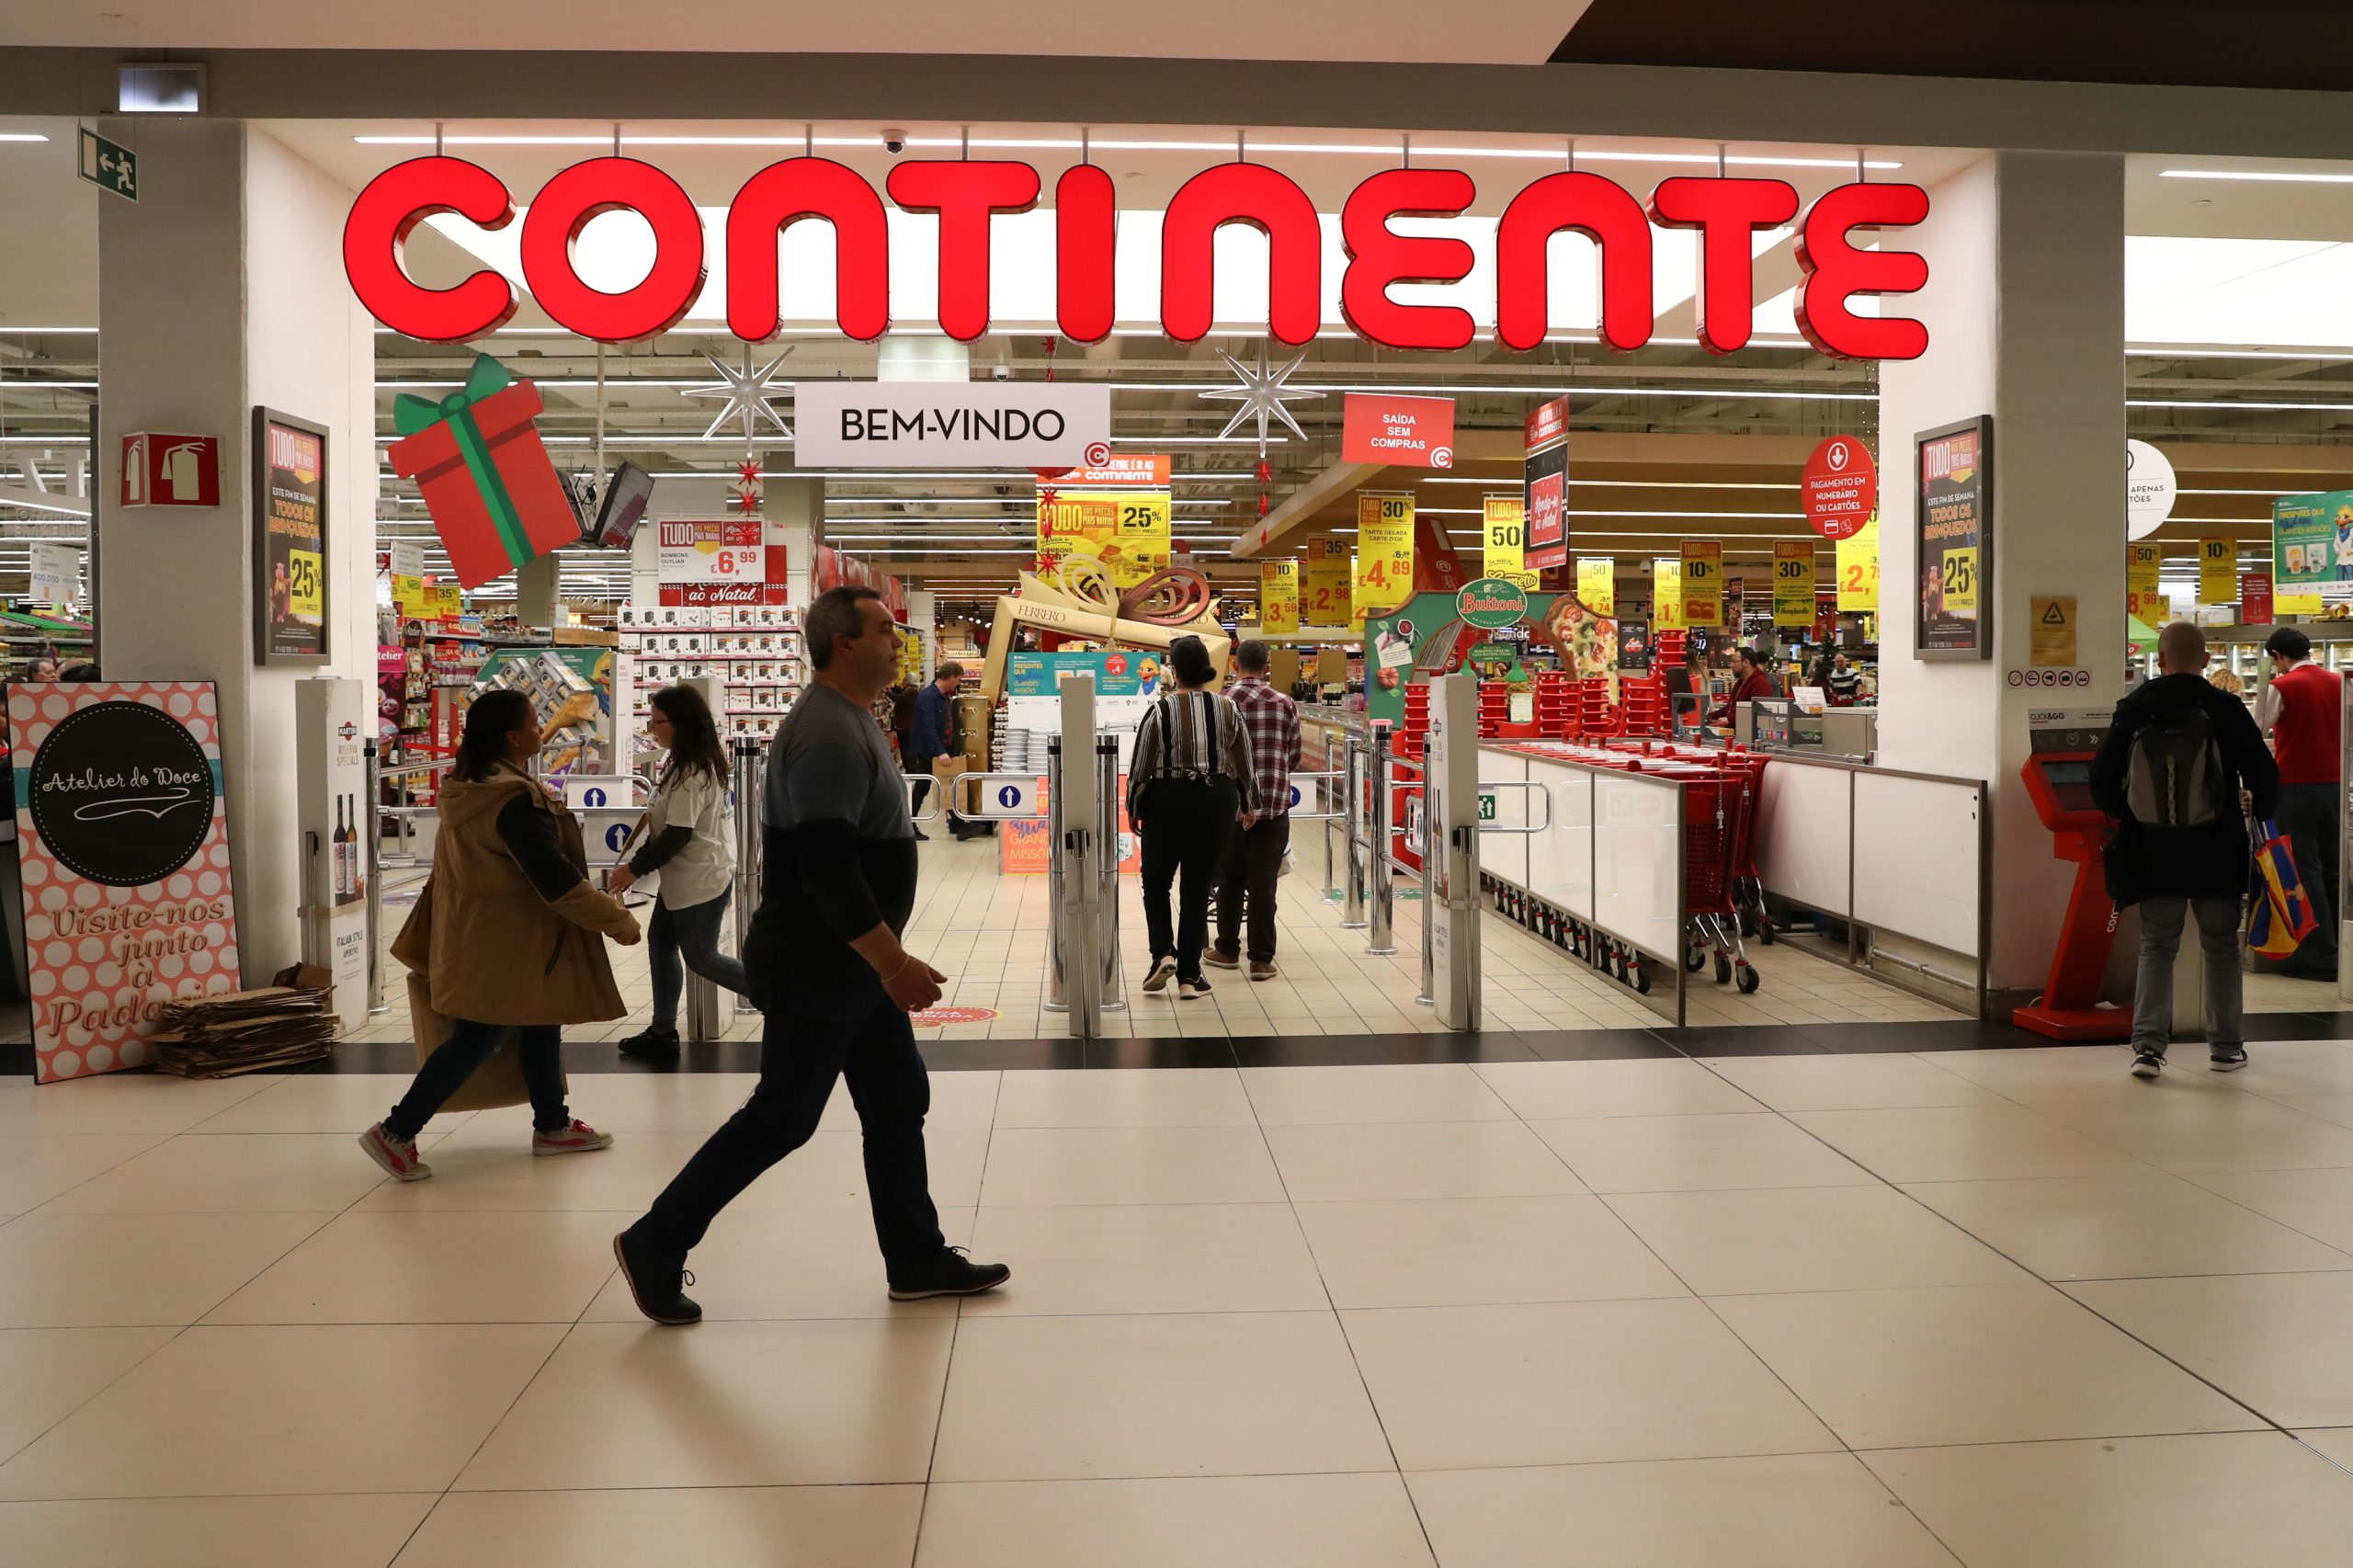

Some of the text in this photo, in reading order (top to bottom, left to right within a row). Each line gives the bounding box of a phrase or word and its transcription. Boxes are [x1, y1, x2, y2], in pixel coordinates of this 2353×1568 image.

[343, 156, 1929, 360] CONTINENTE
[841, 408, 1065, 441] BEM-VINDO
[1382, 413, 1416, 426] SAÍDA
[1387, 426, 1411, 437] SEM
[271, 428, 295, 470] TUDO
[1370, 437, 1426, 450] COMPRAS
[1927, 441, 1950, 478] TUDO
[1085, 472, 1154, 481] CONTINENTE
[1810, 476, 1866, 489] PAGAMENTO EM
[1815, 488, 1859, 501] NUMERÁRIO
[1927, 497, 1938, 506] ESTE
[1954, 491, 1974, 502] SEMANA
[2131, 484, 2165, 494] APENAS
[275, 499, 303, 519] TODOS
[1362, 498, 1380, 511] TUDO
[1382, 500, 1412, 518] 30%
[1488, 502, 1512, 518] TUDO
[1815, 499, 1861, 512] OU CARTÕES
[1930, 502, 1972, 523] TODOS OS
[2279, 507, 2325, 518] PRESENTES QUE
[1123, 506, 1162, 528] 25%
[662, 523, 694, 545] TUDO
[1492, 526, 1523, 547] 50
[1925, 517, 1978, 540] BRINQUEDOS
[291, 557, 322, 598] 25%
[1779, 561, 1809, 578] 30%
[1944, 555, 1978, 595] 25%
[688, 591, 706, 602] ao
[710, 585, 757, 602] Natal
[1461, 592, 1524, 614] Buitoni
[1017, 604, 1066, 623] FERRERO
[2029, 712, 2065, 721] CLICK&GO
[42, 767, 202, 793] Atelier do Doce
[49, 899, 226, 937] Visite-nos
[118, 932, 209, 968] junto
[131, 962, 155, 988] à
